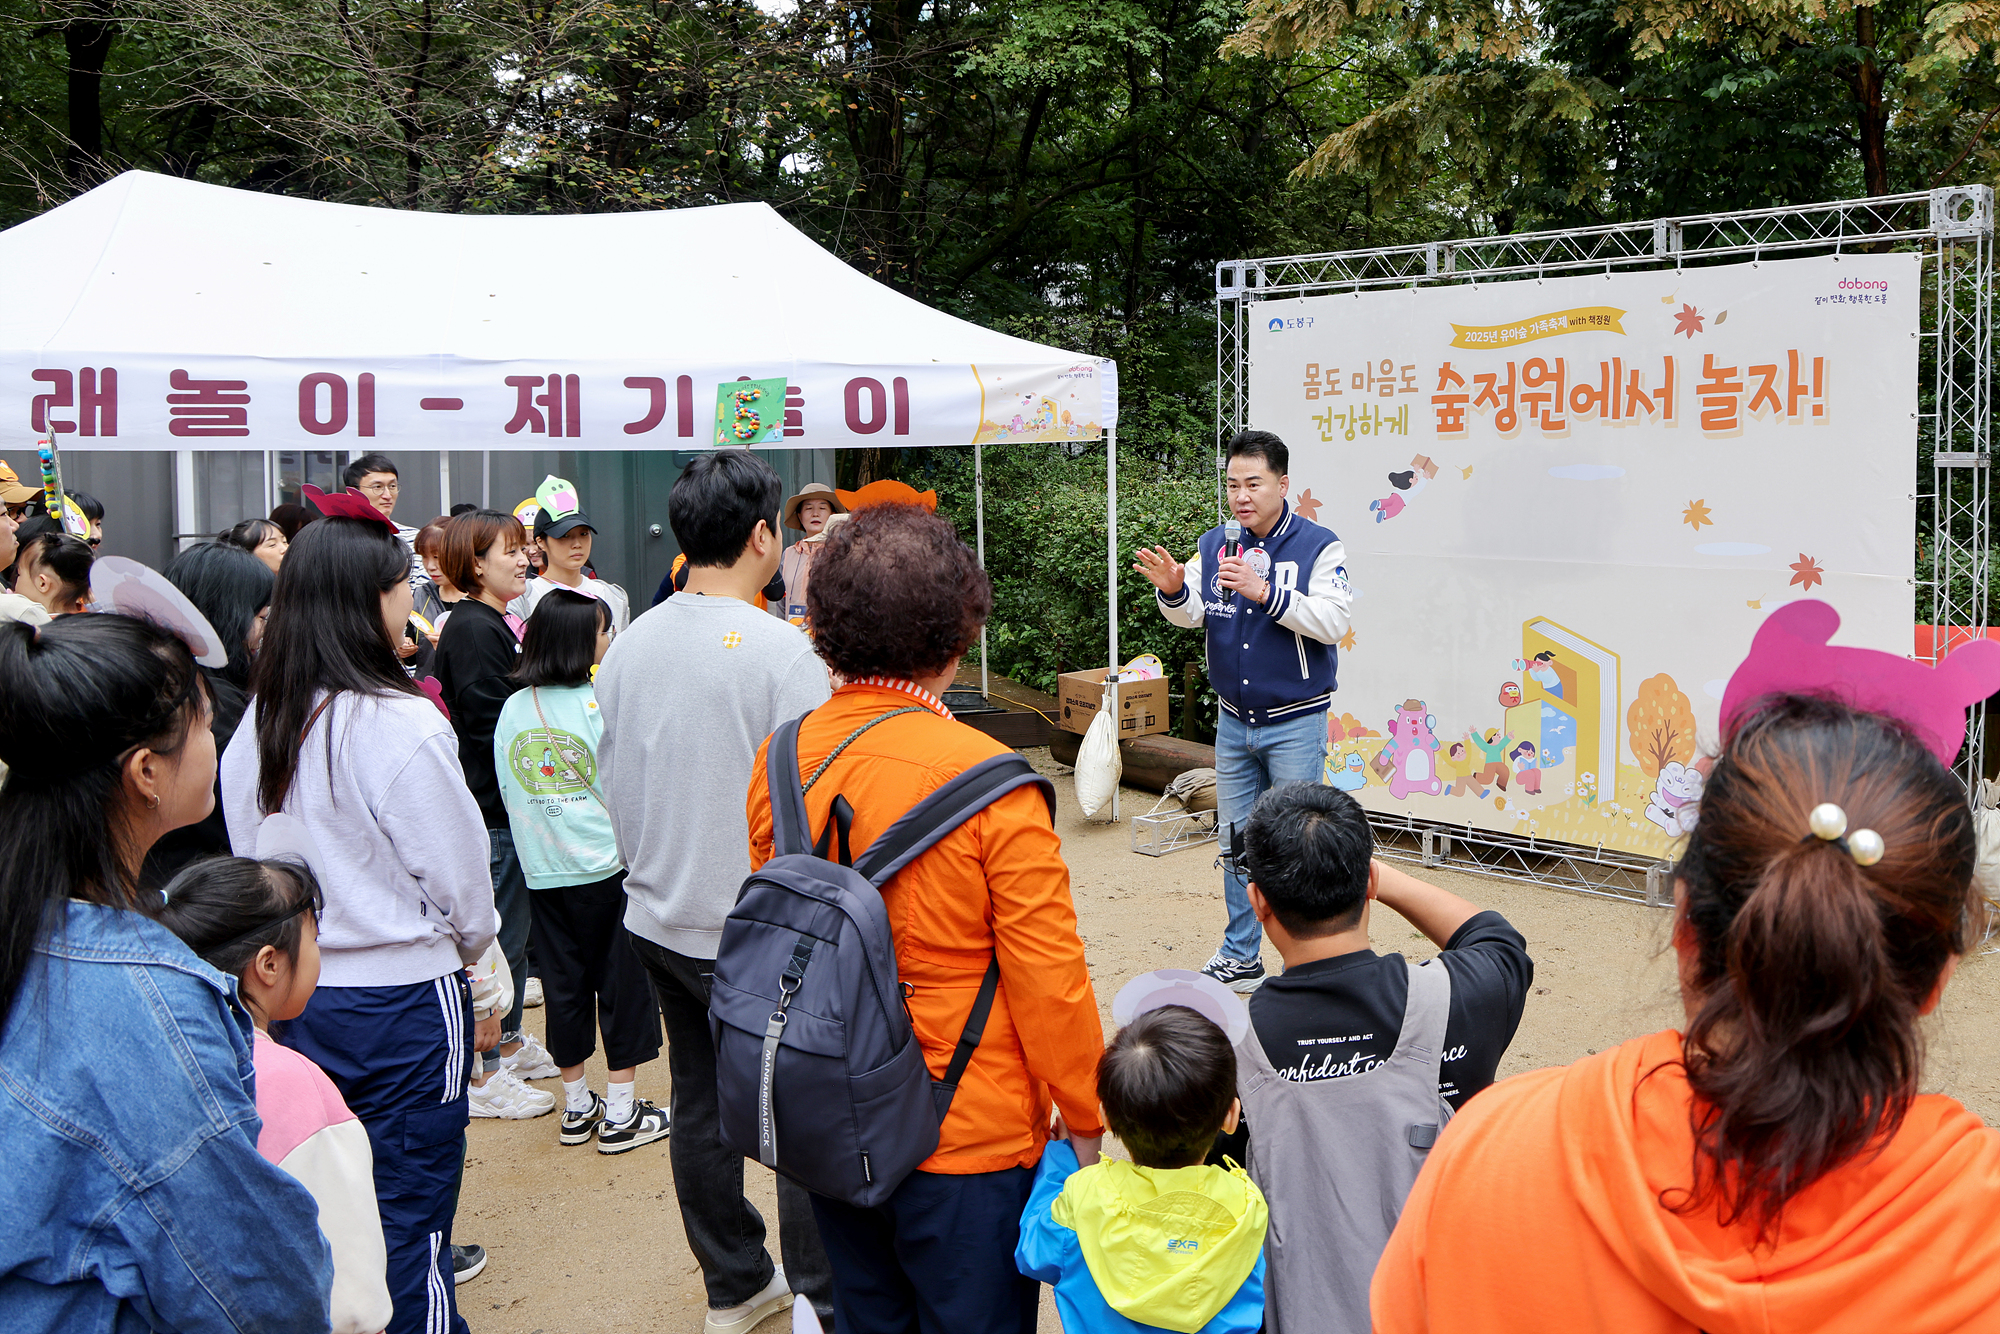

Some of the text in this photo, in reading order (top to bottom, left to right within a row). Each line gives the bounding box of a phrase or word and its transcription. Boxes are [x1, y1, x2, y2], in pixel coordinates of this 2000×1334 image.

[1838, 277, 1888, 292] dobong
[1814, 296, 1828, 306] 같이
[1848, 294, 1872, 304] 행복한
[1874, 294, 1888, 304] 도봉
[1286, 317, 1315, 329] 도봉구
[1464, 314, 1611, 344] 2025년 유아숲 가족축제 with 책정원
[1303, 358, 1419, 400] 몸도 마음도
[1431, 349, 1825, 433] 숲정원에서 놀자!
[504, 372, 910, 438] 제기이
[1311, 402, 1409, 442] 건강하게
[1297, 1033, 1374, 1046] TRUST YOURSELF AND ACT
[1274, 1053, 1376, 1082] onfident
